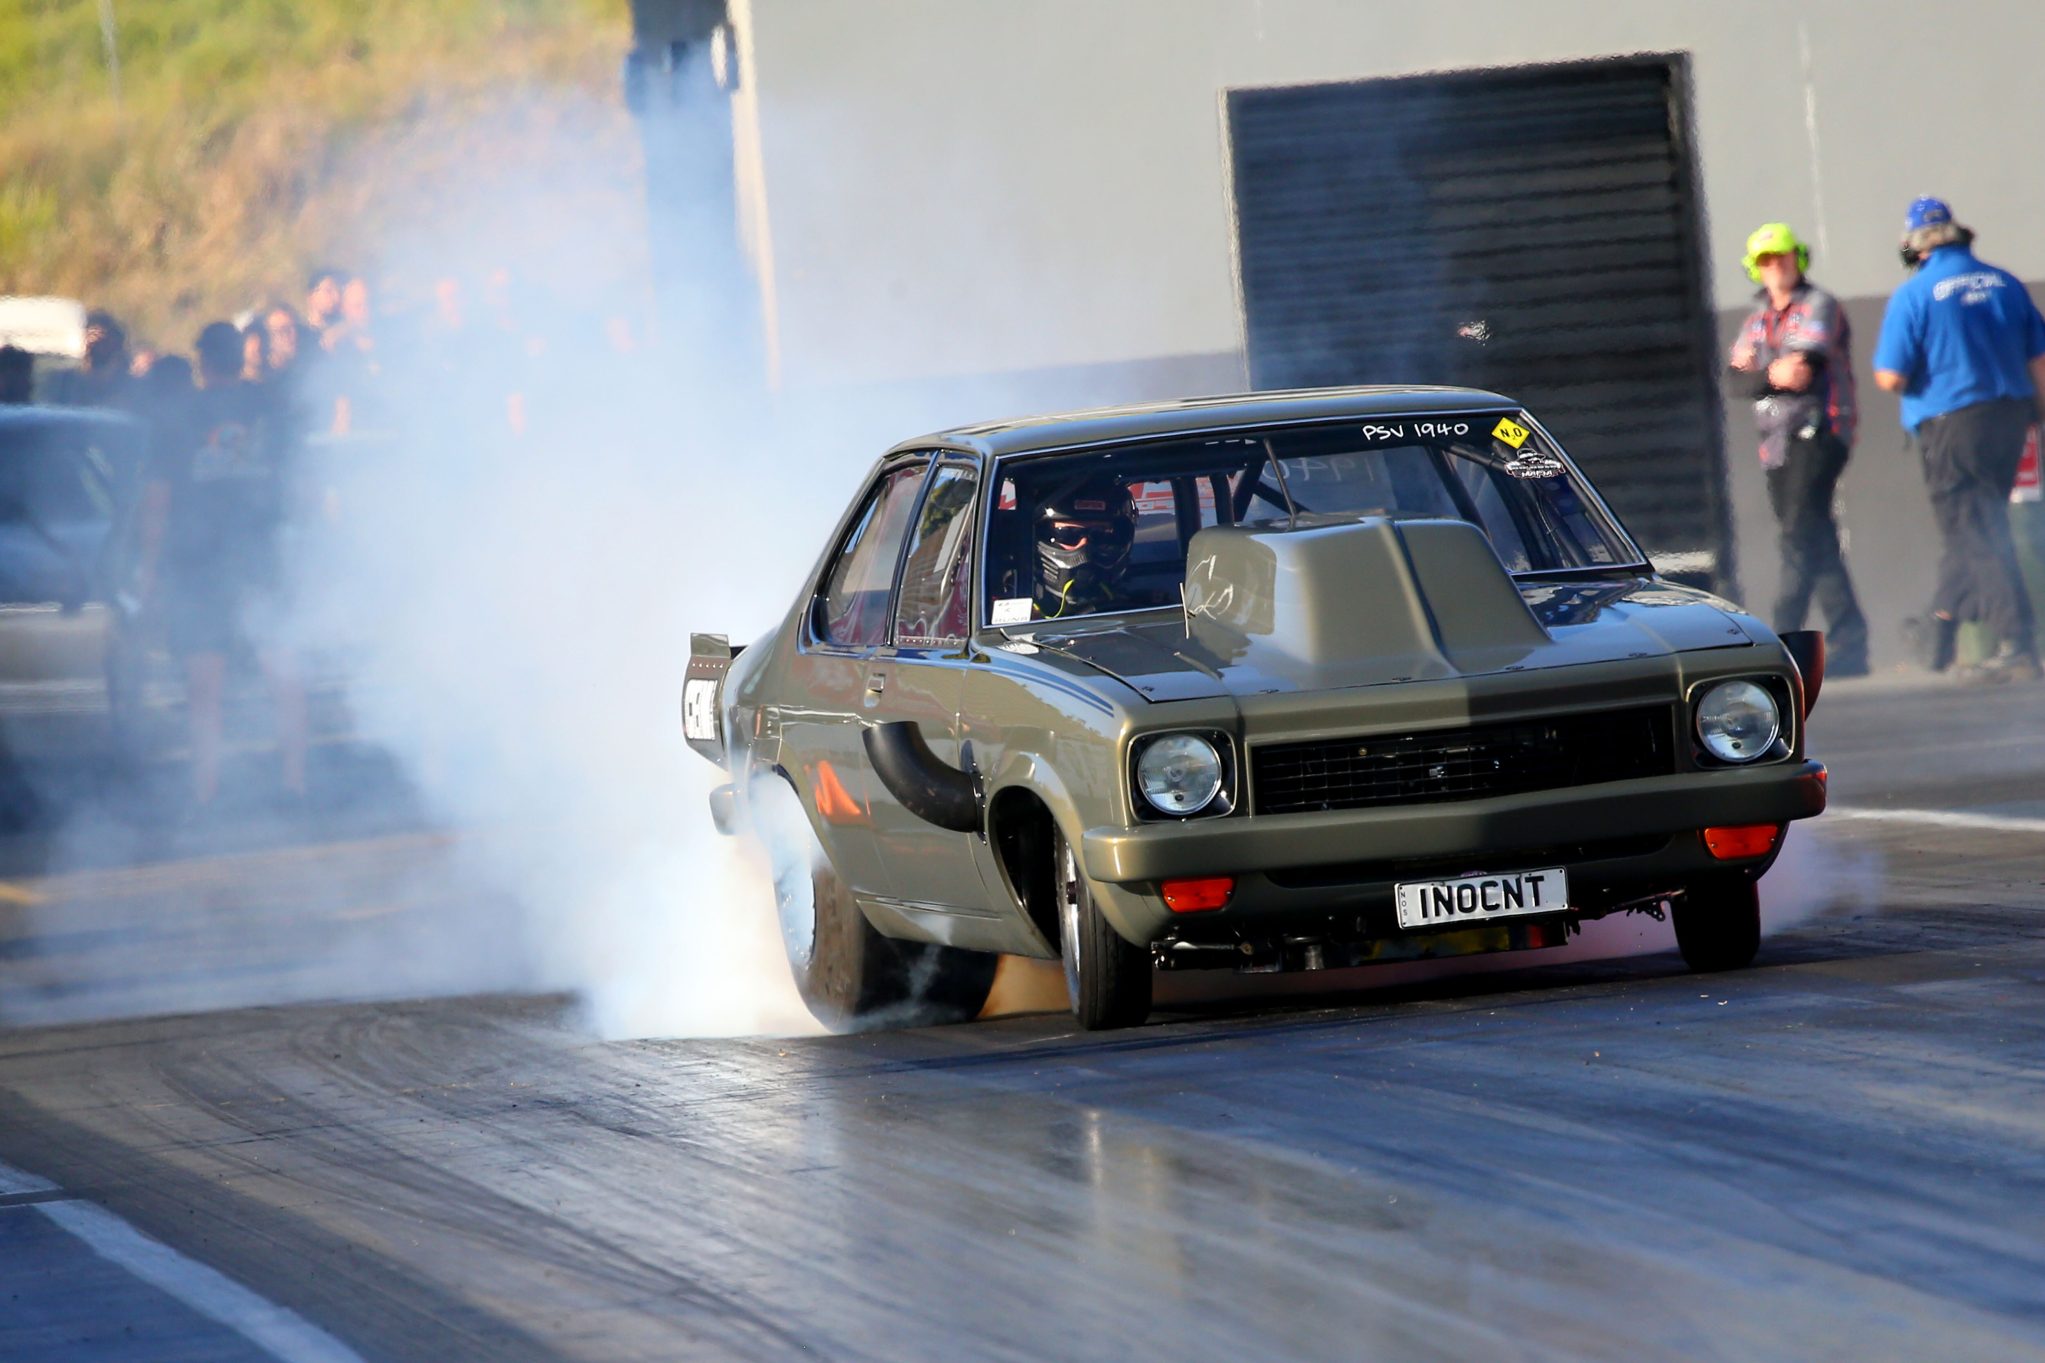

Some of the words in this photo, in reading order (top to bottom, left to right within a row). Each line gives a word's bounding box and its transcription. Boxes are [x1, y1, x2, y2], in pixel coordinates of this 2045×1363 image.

[1362, 424, 1404, 441] PSV
[1414, 423, 1469, 438] 1940
[1419, 875, 1545, 919] INOCNT
